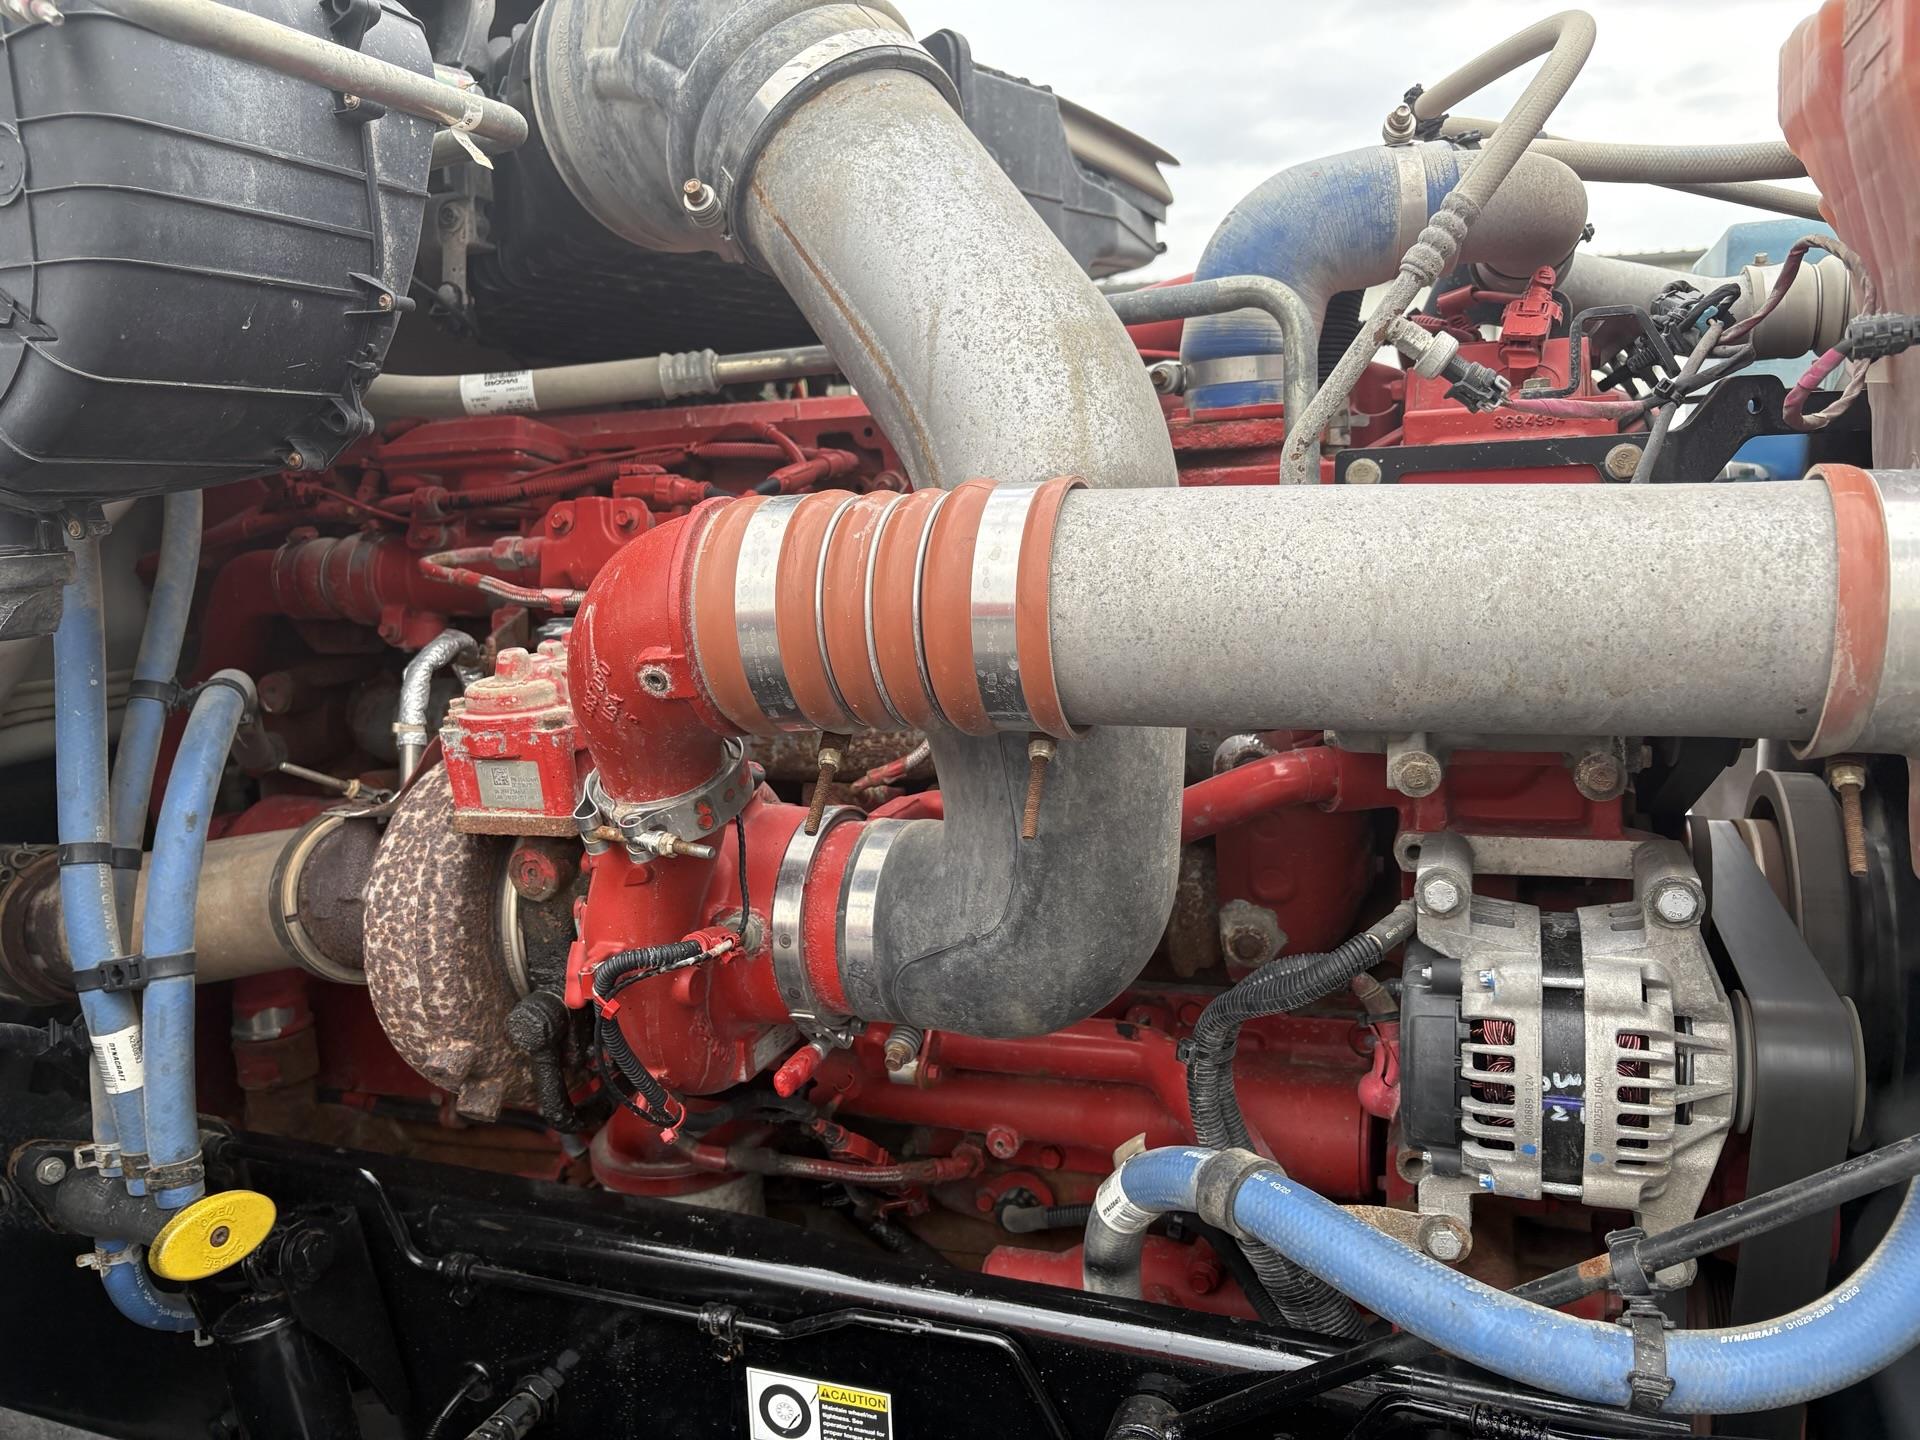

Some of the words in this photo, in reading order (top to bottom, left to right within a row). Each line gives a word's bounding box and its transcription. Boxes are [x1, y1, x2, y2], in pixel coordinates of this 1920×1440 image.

[108, 1042, 127, 1081] DYNACRAFT
[200, 1205, 236, 1228] OPEN
[830, 1390, 886, 1409] CAUTION
[851, 1417, 864, 1425] See
[823, 1429, 843, 1437] proper
[853, 1427, 876, 1436] manual
[876, 1430, 886, 1438] for
